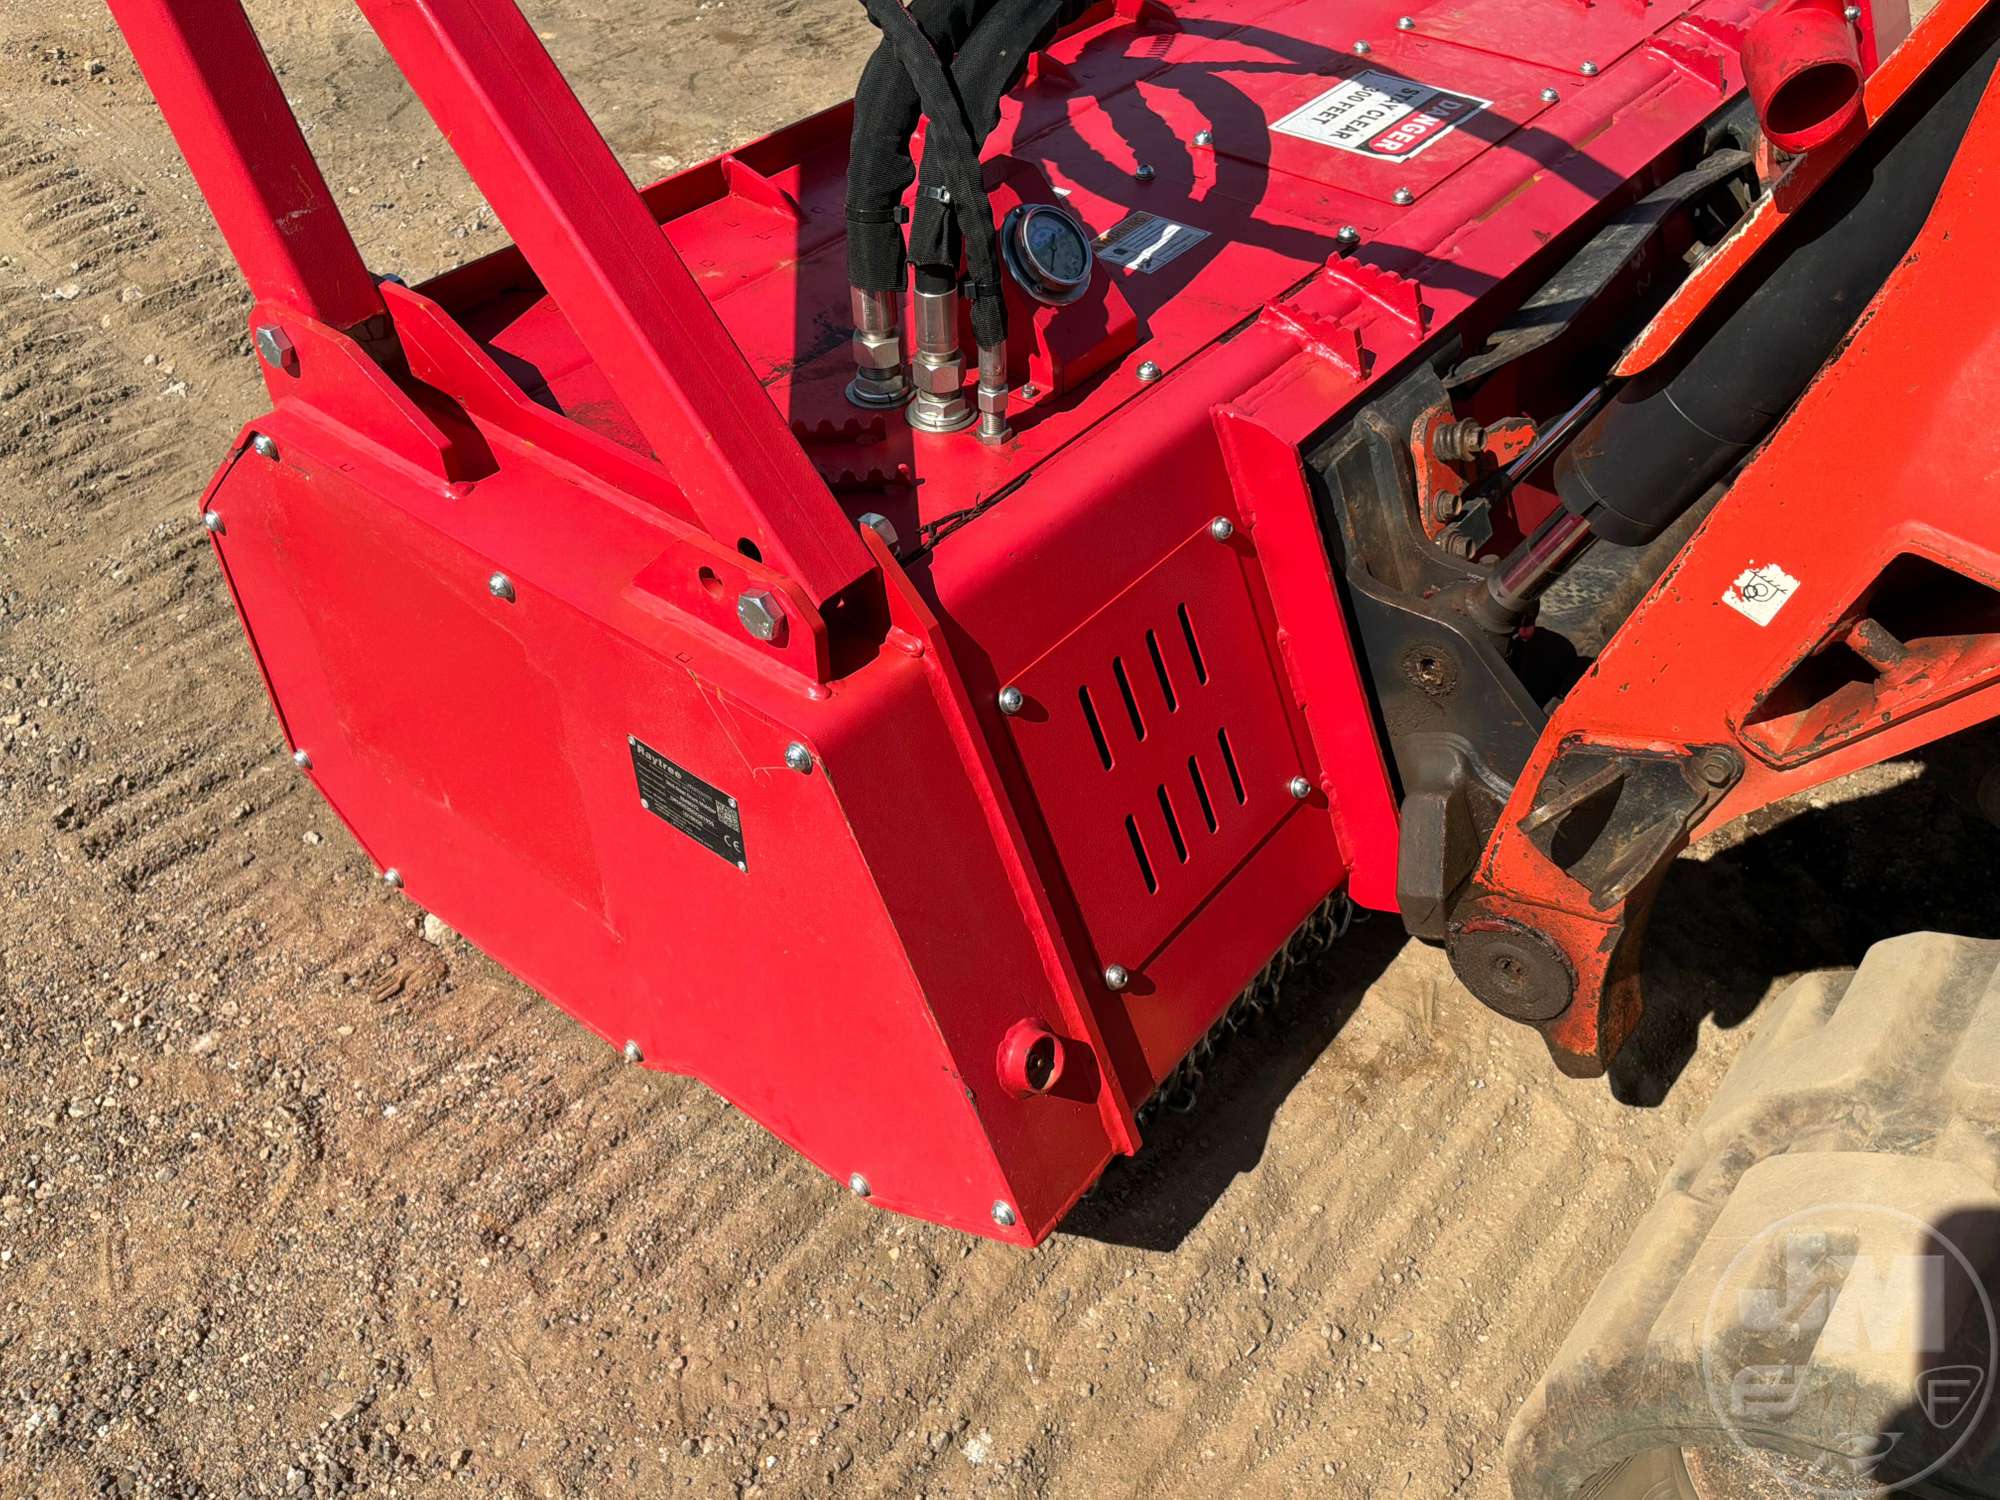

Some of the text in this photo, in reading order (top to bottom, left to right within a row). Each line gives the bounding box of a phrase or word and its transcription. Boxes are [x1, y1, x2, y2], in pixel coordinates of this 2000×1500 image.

[1312, 100, 1354, 126] FEET
[1330, 87, 1420, 141] STAY CLEAR
[1374, 98, 1463, 152] DANGER
[636, 744, 683, 780] Raytree
